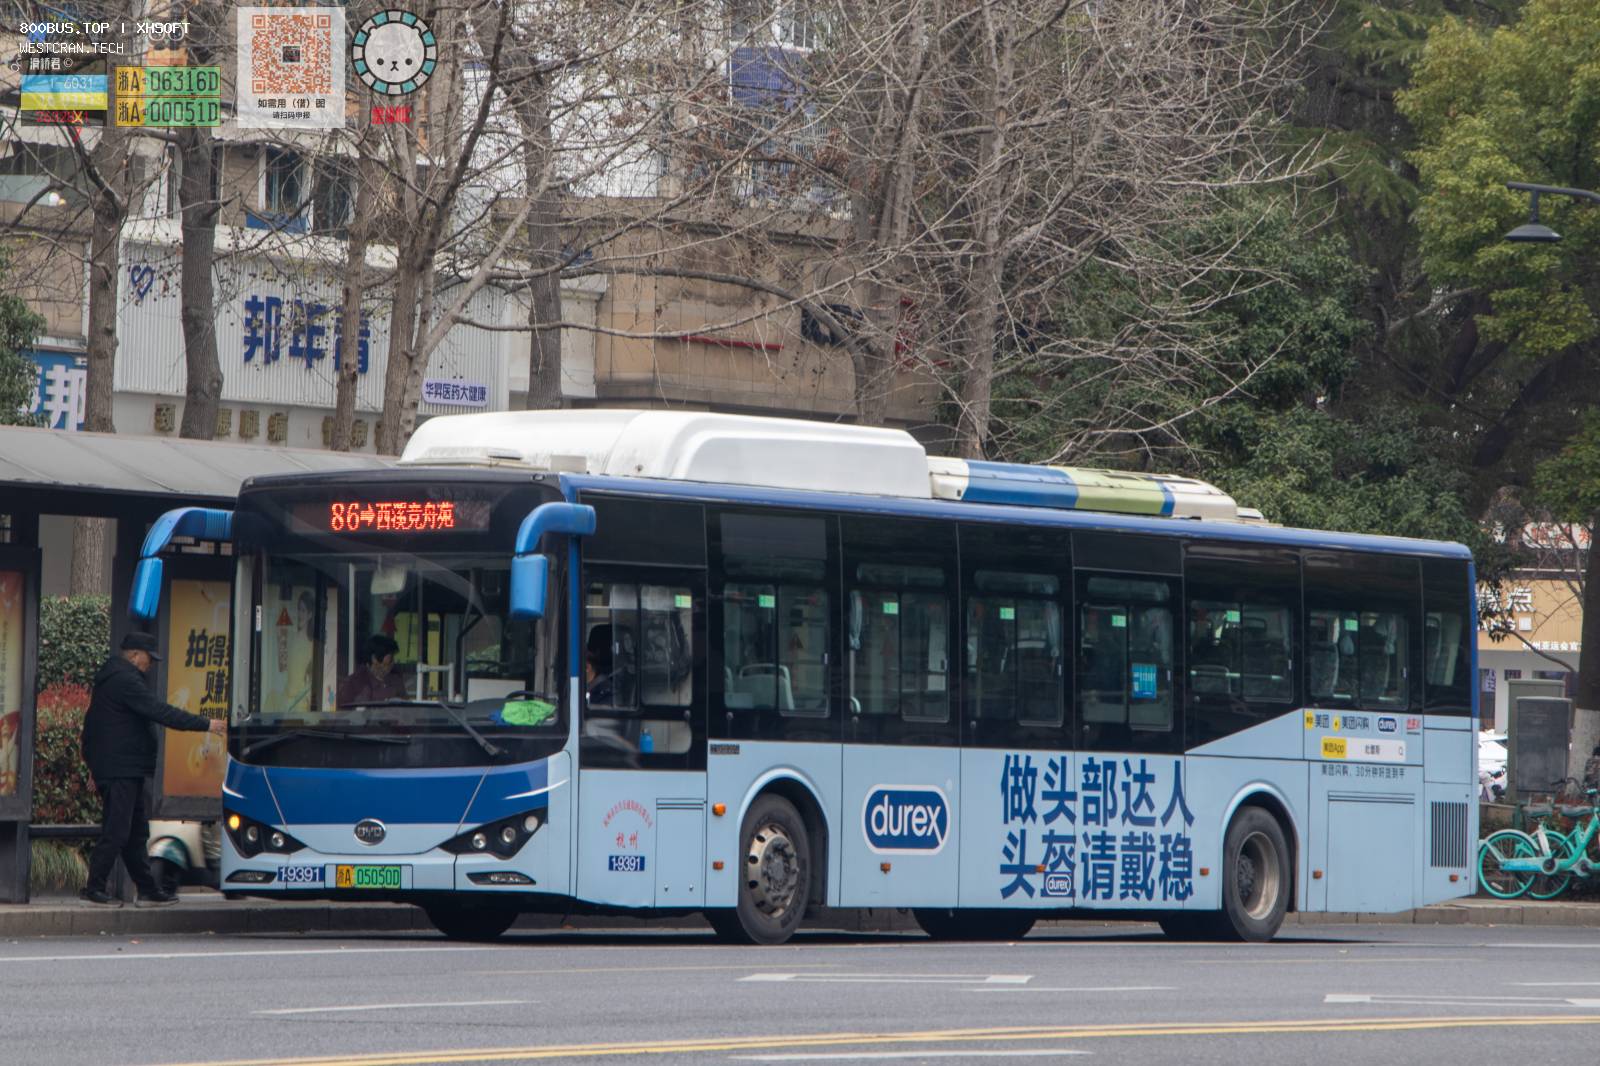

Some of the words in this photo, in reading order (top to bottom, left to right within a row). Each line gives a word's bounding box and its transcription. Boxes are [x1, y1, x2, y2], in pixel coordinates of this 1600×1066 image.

[331, 502, 360, 531] 86
[185, 627, 229, 668] 拍得
[1000, 754, 1195, 828] 做头部达人
[870, 793, 944, 844] durex
[1000, 829, 1194, 902] 头盔请戴稳
